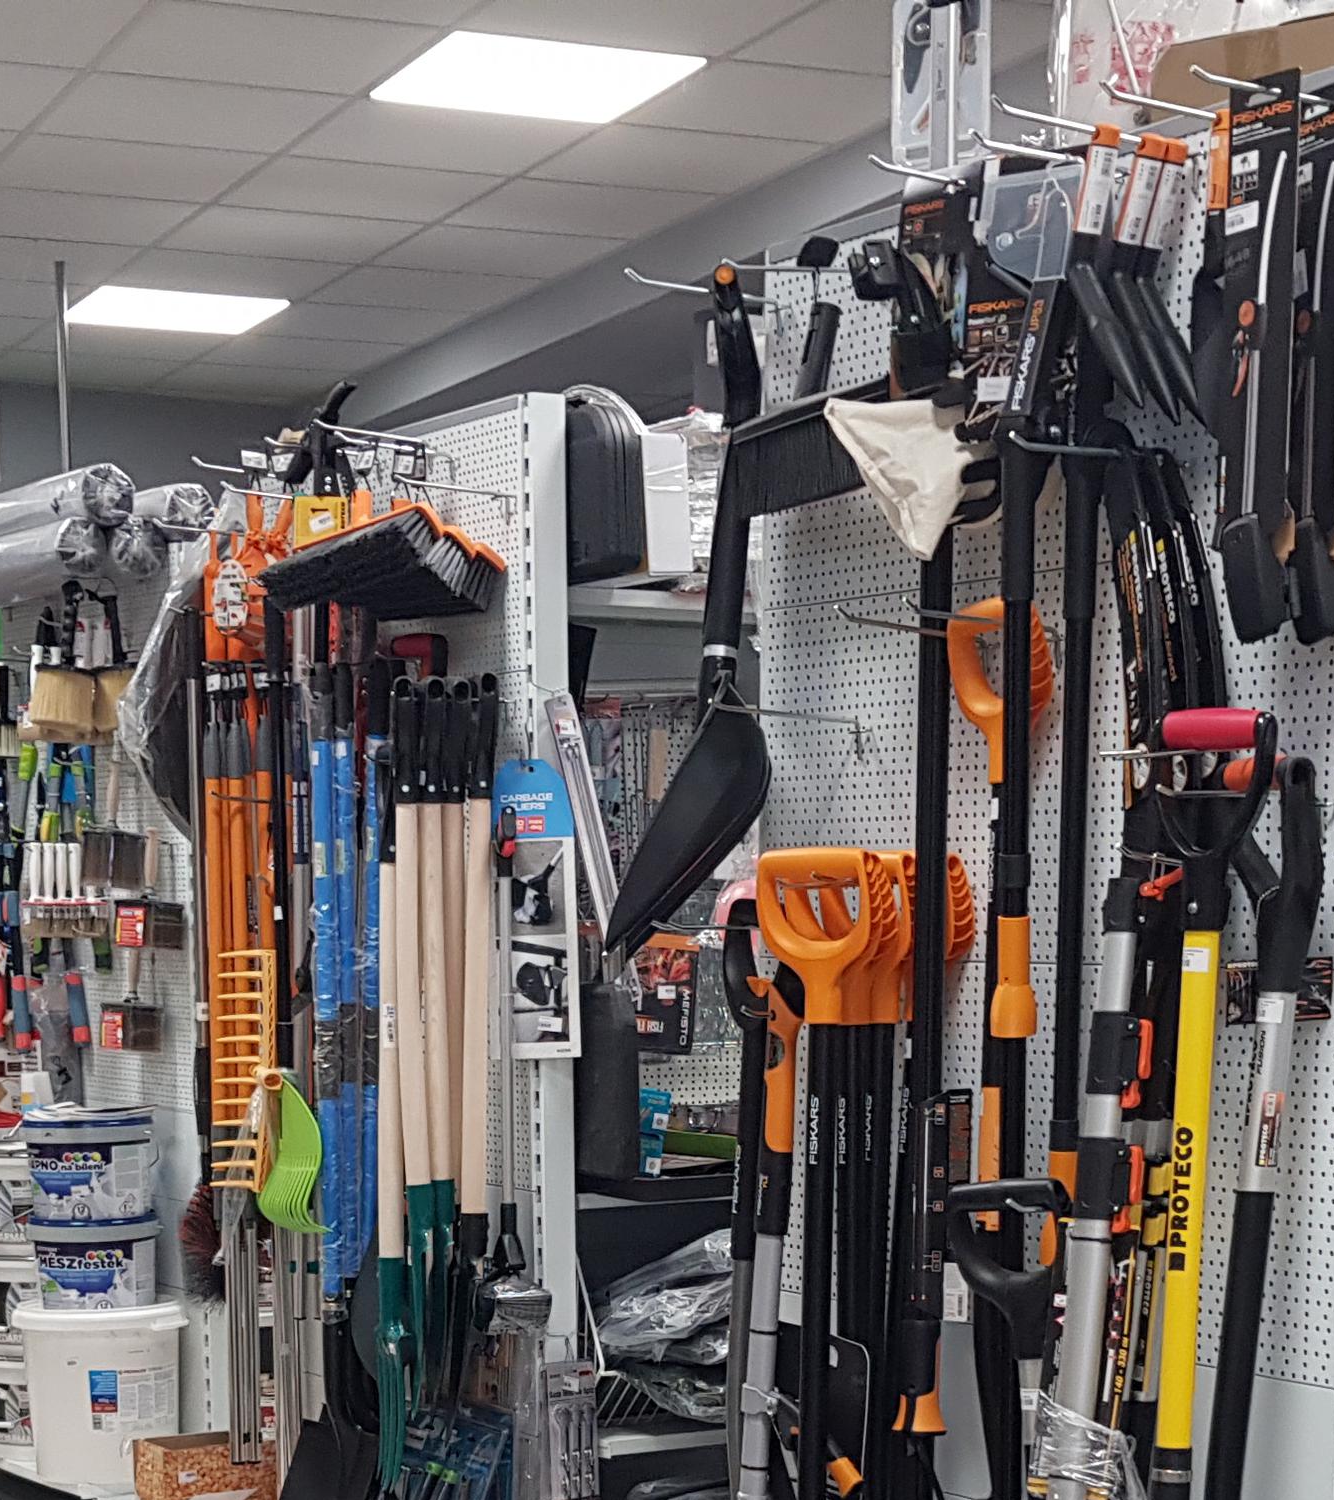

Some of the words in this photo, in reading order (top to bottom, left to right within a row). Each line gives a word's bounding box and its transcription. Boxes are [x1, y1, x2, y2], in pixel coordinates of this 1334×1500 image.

[1230, 100, 1295, 127] FISKARS
[1010, 334, 1037, 412] FISKARS
[678, 988, 694, 1047] MEFISTO
[808, 1094, 820, 1166] FISKARS
[838, 1097, 847, 1165] FISKARS
[898, 1086, 913, 1154] FISKARS
[1170, 1124, 1195, 1248] PROTECO
